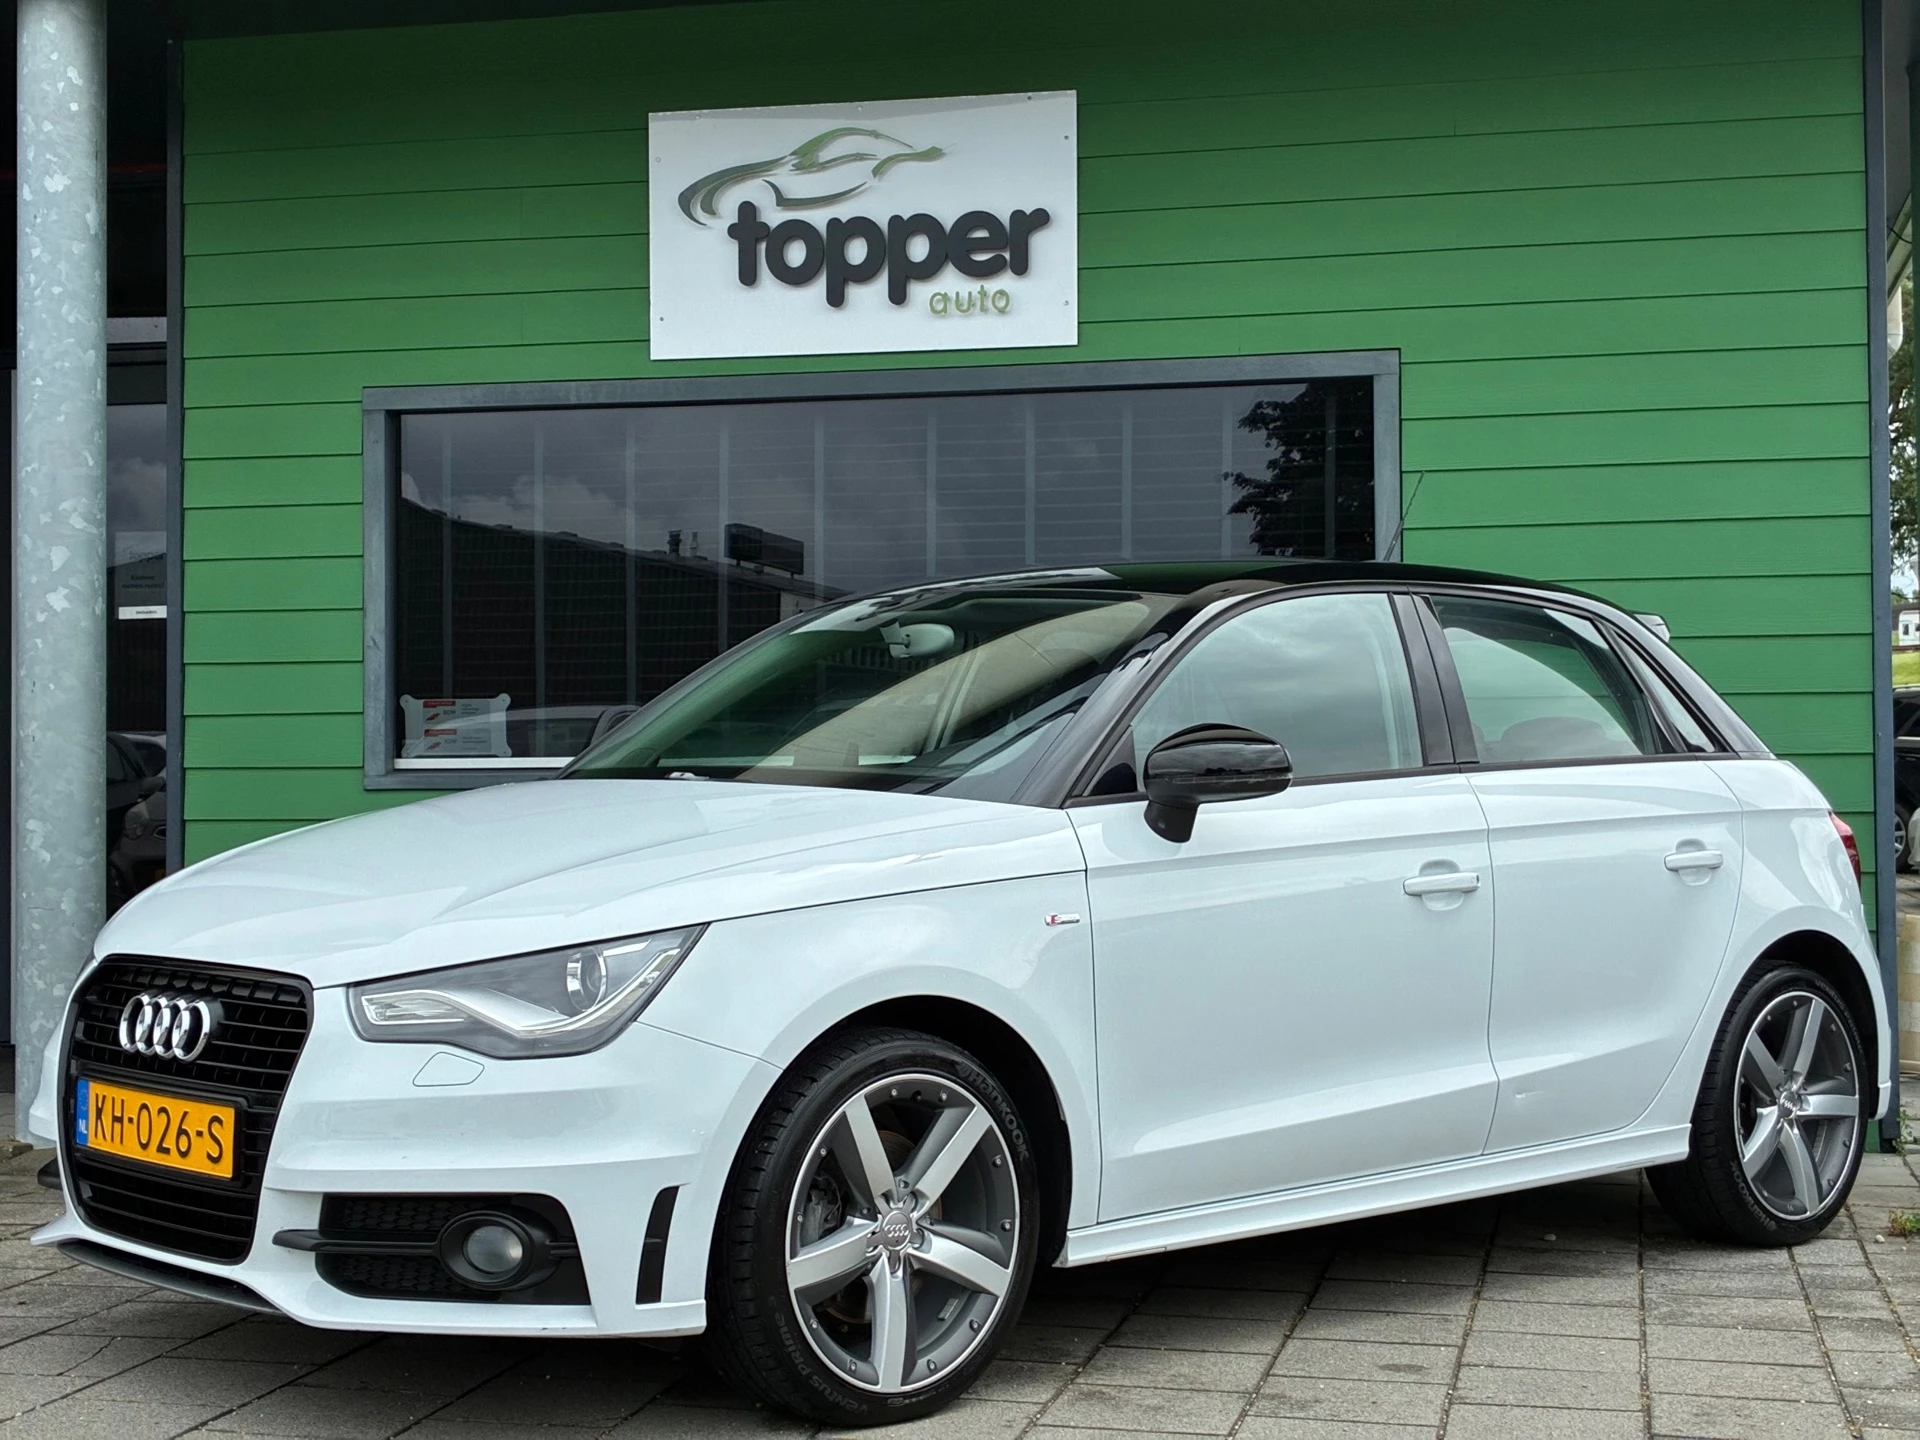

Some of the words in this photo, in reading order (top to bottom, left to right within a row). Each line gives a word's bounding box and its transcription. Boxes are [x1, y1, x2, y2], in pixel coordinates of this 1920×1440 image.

[727, 200, 1051, 308] topper
[928, 284, 1011, 316] auto
[78, 1119, 88, 1134] NL
[94, 1092, 224, 1164] KH-026-S
